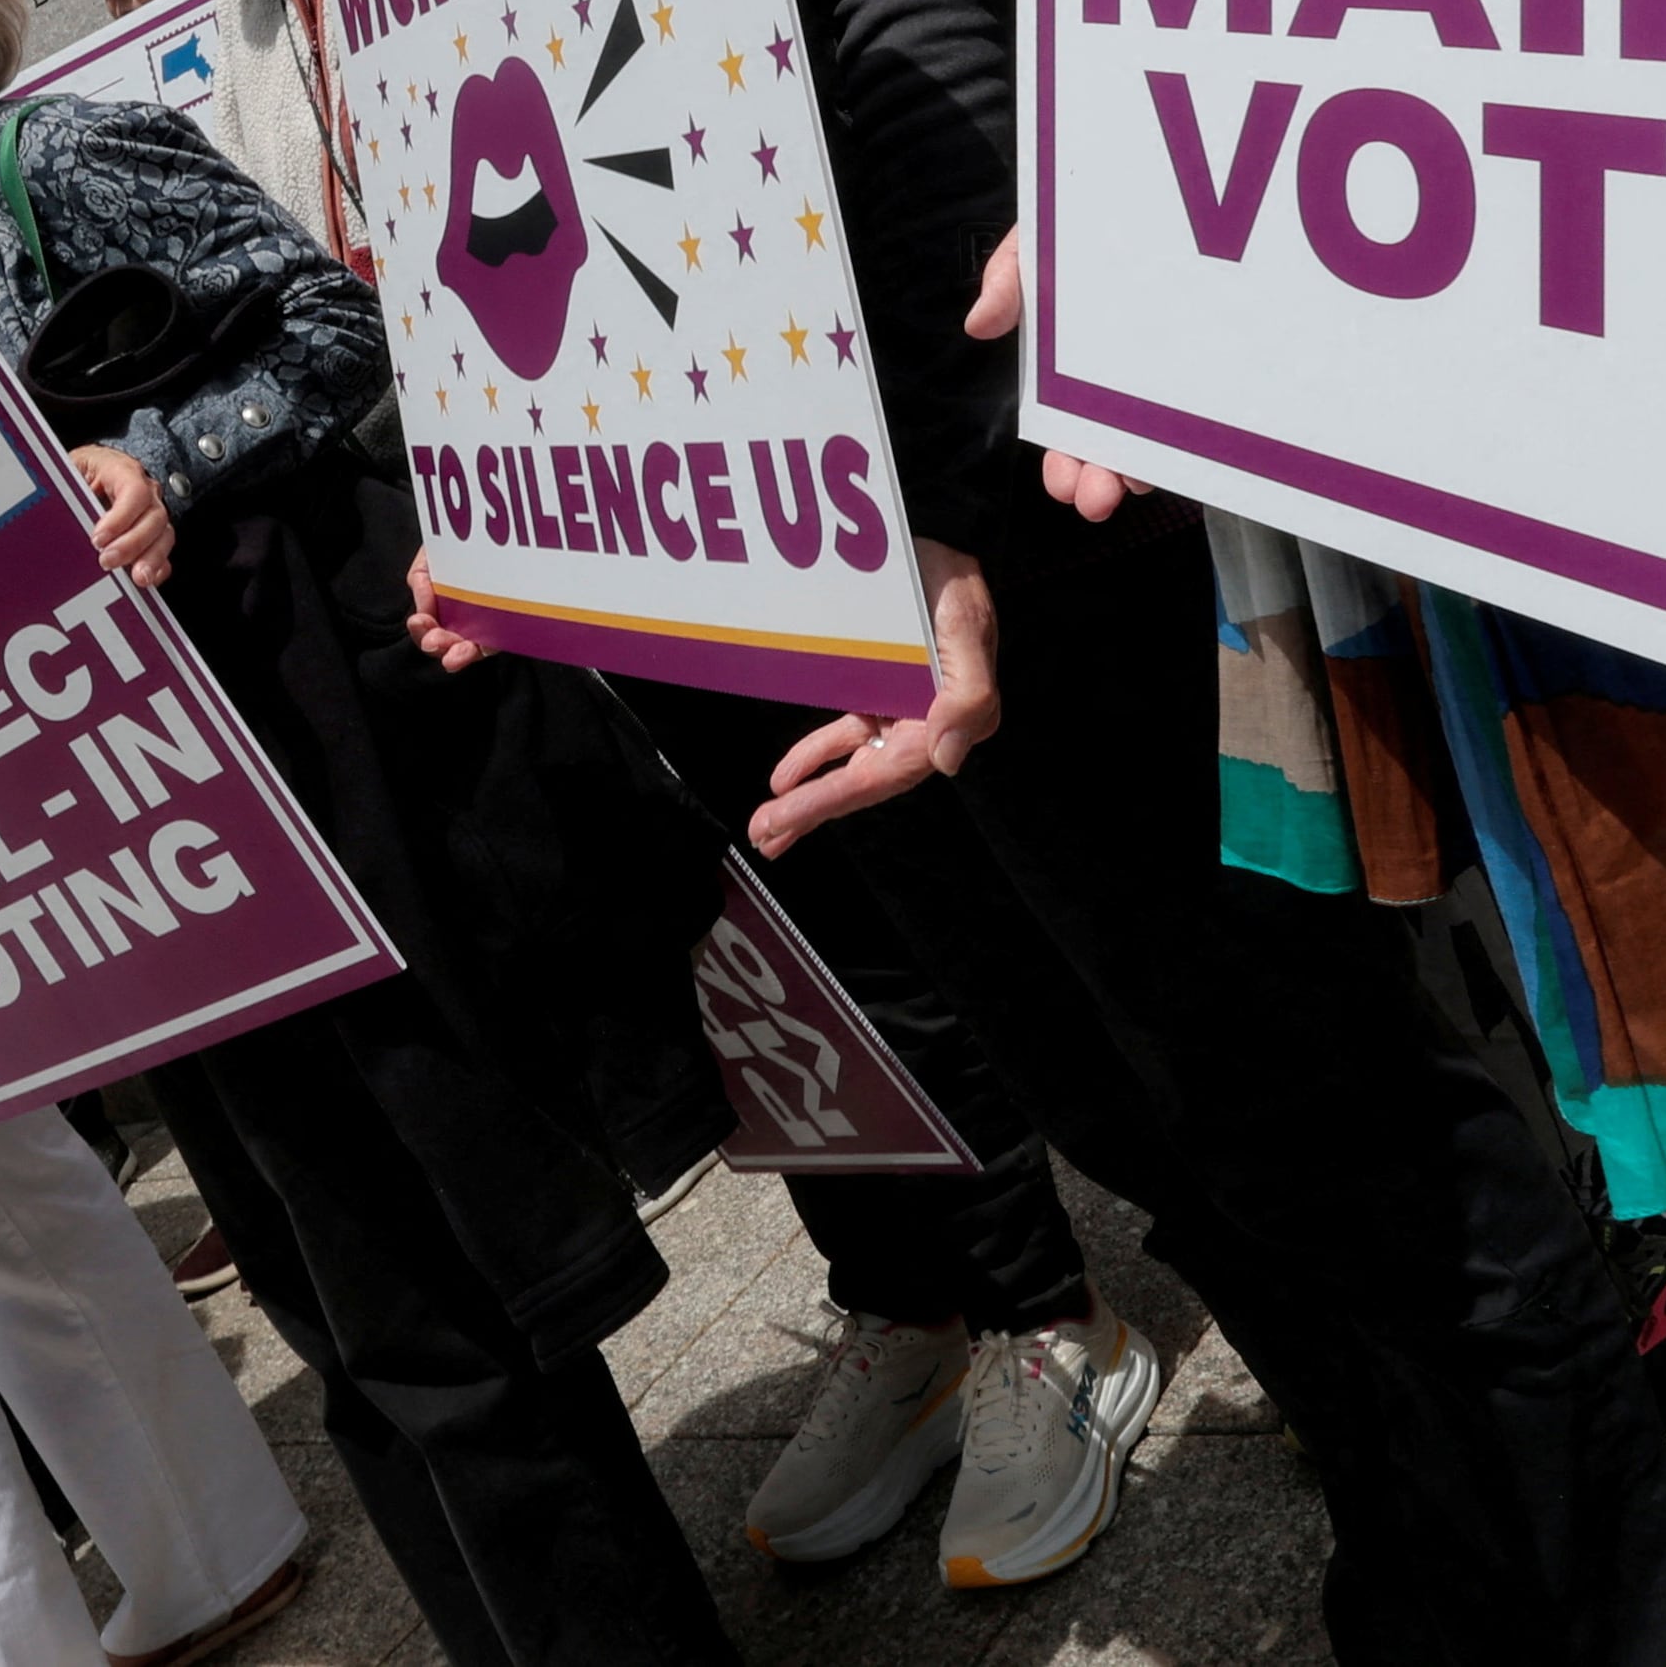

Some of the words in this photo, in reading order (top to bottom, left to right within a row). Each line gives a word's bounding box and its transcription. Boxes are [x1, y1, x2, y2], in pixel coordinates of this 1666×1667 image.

[411, 443, 473, 544] TO
[477, 439, 749, 564] SILENCE
[750, 434, 888, 573] US
